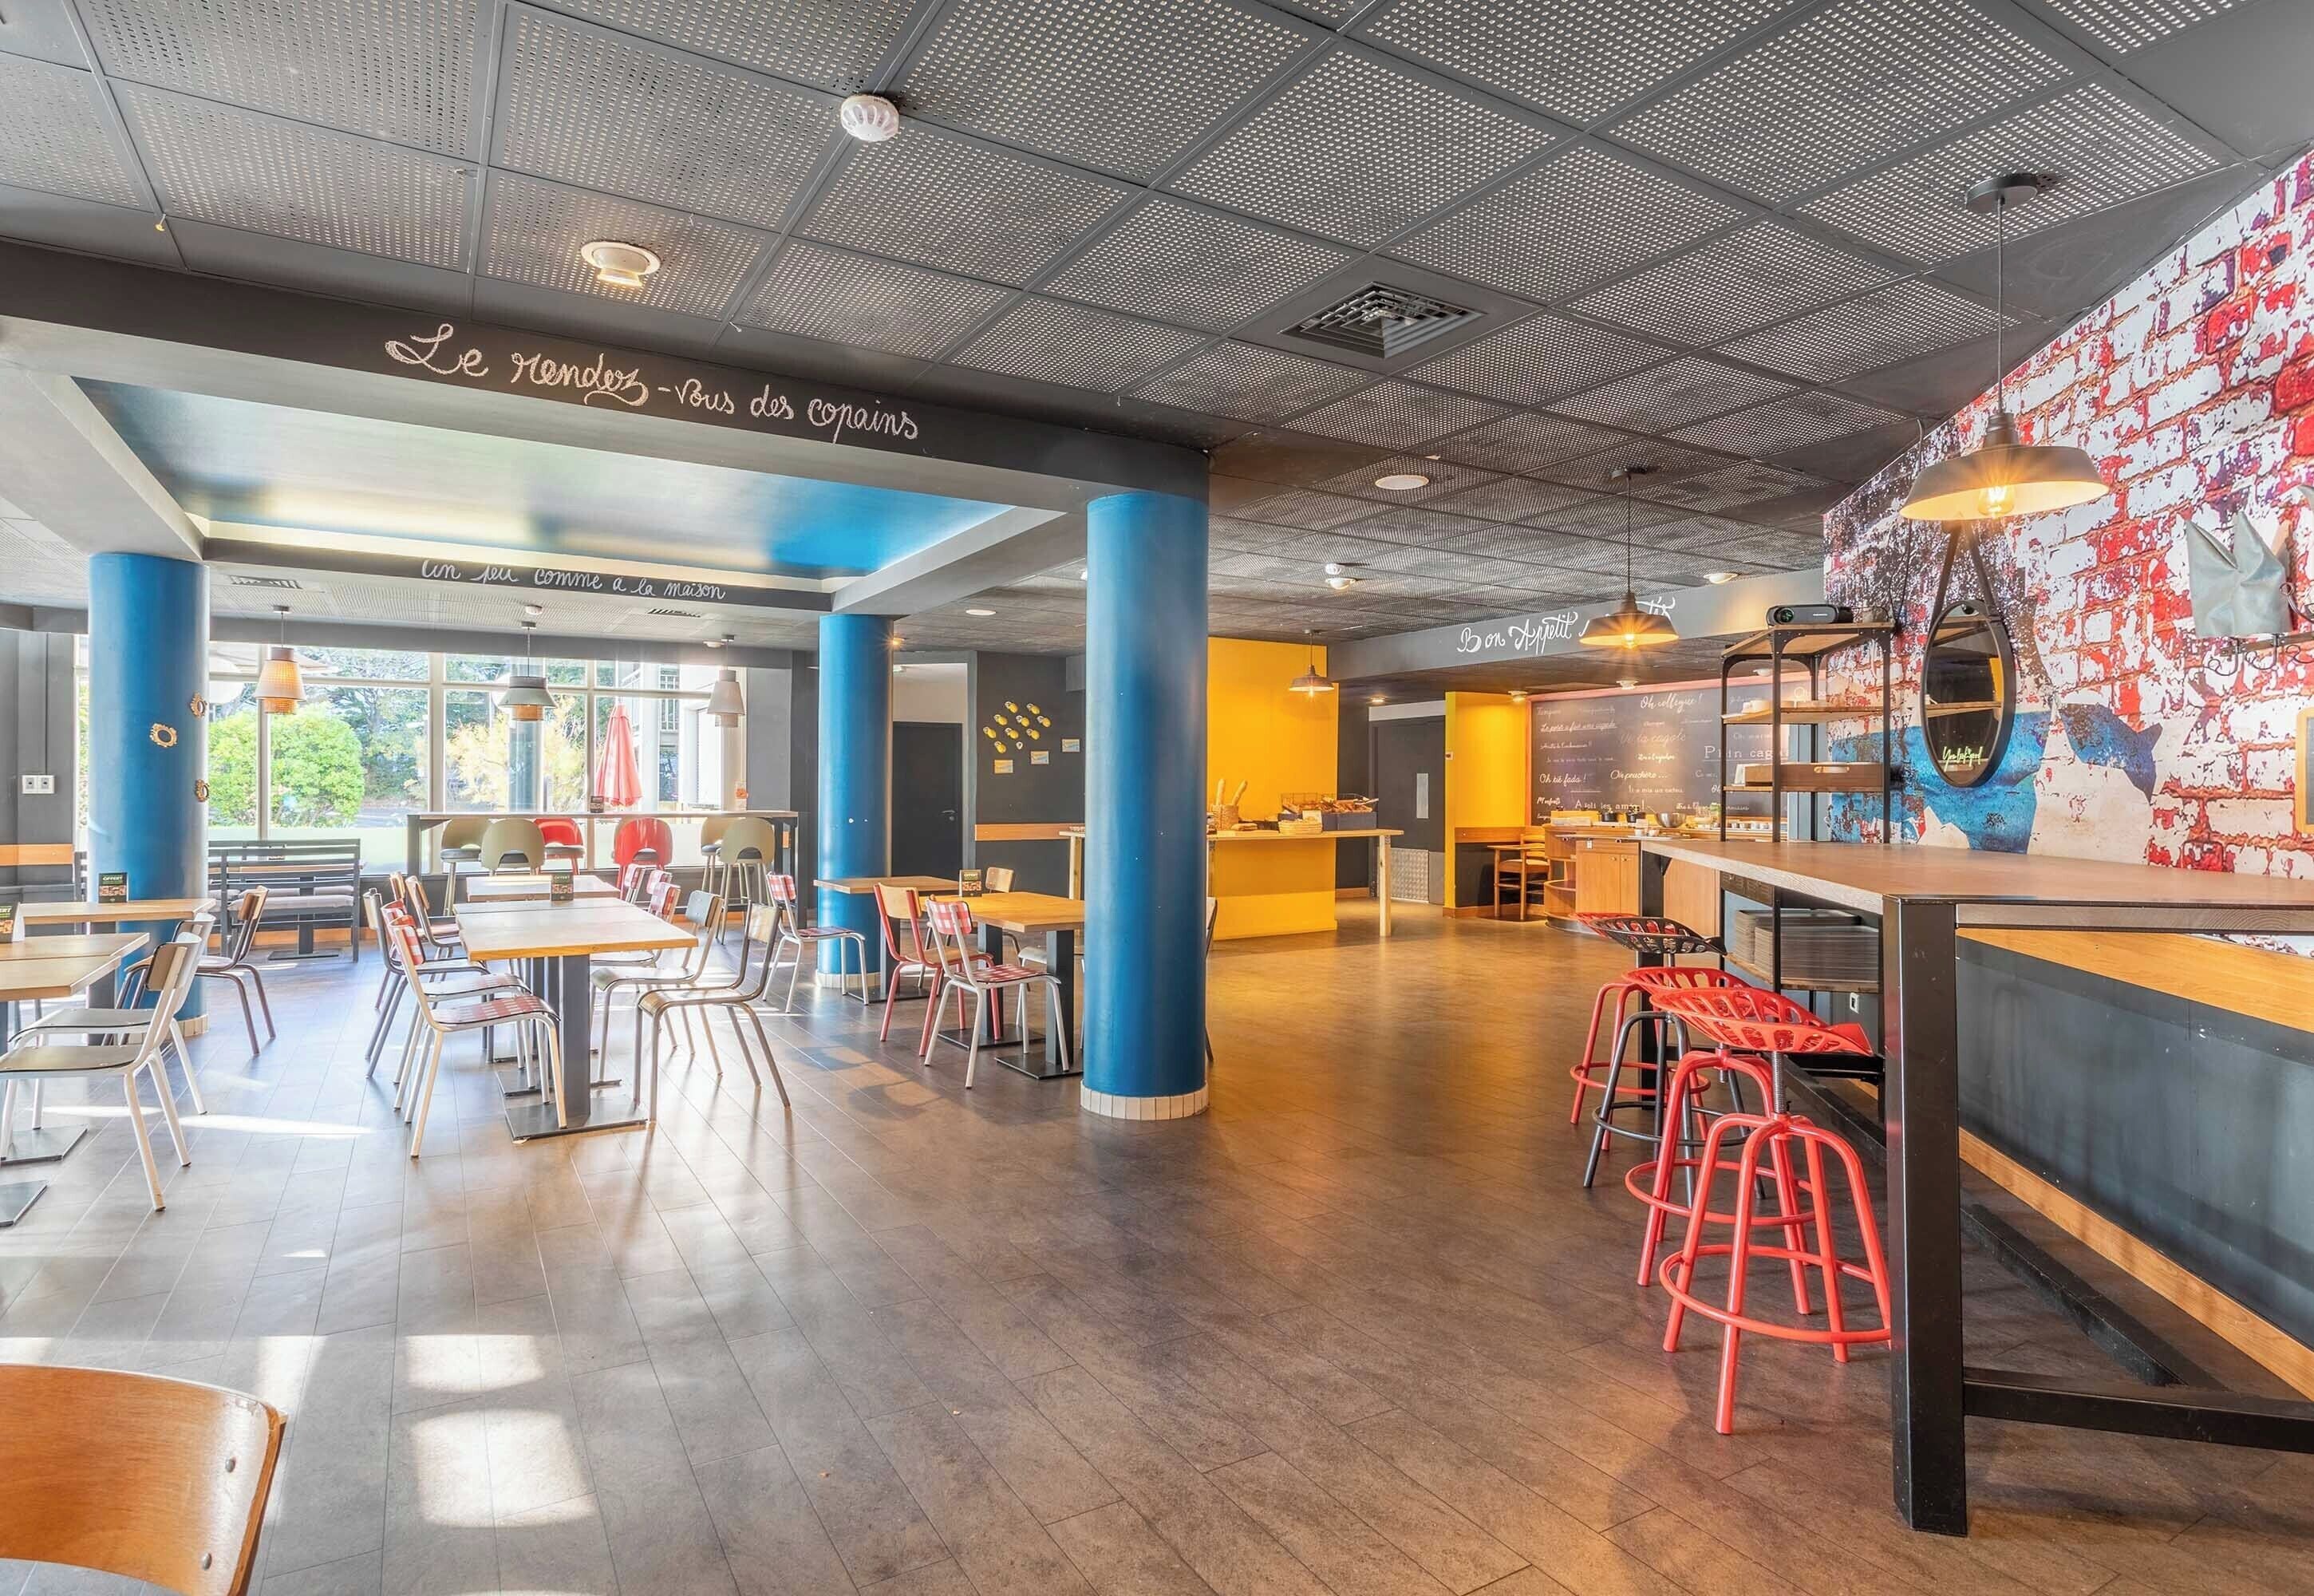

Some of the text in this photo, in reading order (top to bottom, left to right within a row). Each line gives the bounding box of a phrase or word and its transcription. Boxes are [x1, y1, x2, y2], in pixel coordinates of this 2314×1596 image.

[385, 323, 488, 377] Le
[750, 384, 795, 420] des
[808, 398, 918, 446] copains
[469, 565, 519, 584] peu
[534, 568, 602, 590] comme
[630, 579, 657, 596] la
[664, 582, 726, 599] maison
[1457, 626, 1506, 653] Bon
